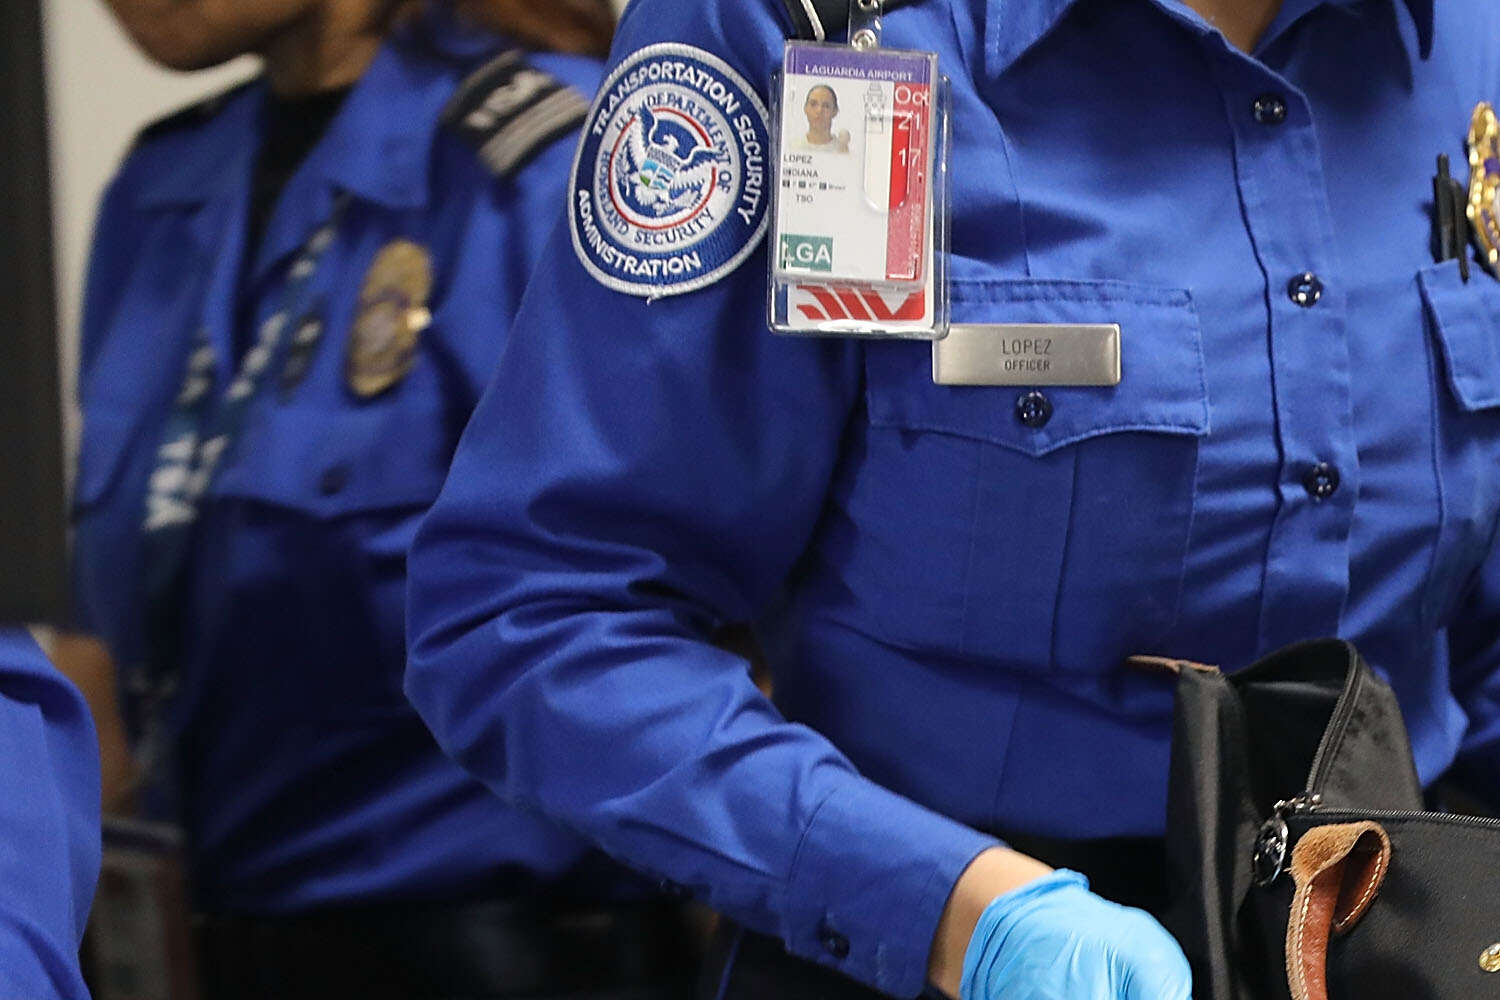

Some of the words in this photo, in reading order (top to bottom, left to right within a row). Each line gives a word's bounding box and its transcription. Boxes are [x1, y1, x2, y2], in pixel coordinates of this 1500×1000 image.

[805, 64, 866, 78] LAGUARDIA
[867, 69, 912, 82] AIRPORT
[894, 85, 930, 107] Oct
[897, 111, 921, 131] 21
[592, 61, 740, 136] TRANSPORTATION
[733, 113, 764, 225] SECURITY
[783, 153, 813, 165] LOPEZ
[897, 148, 921, 168] 17
[718, 171, 733, 194] OF
[578, 189, 702, 278] ADMINISTRATION
[633, 207, 715, 245] SECURITY
[1002, 338, 1052, 356] LOPEZ
[1004, 358, 1051, 372] OFFICER
